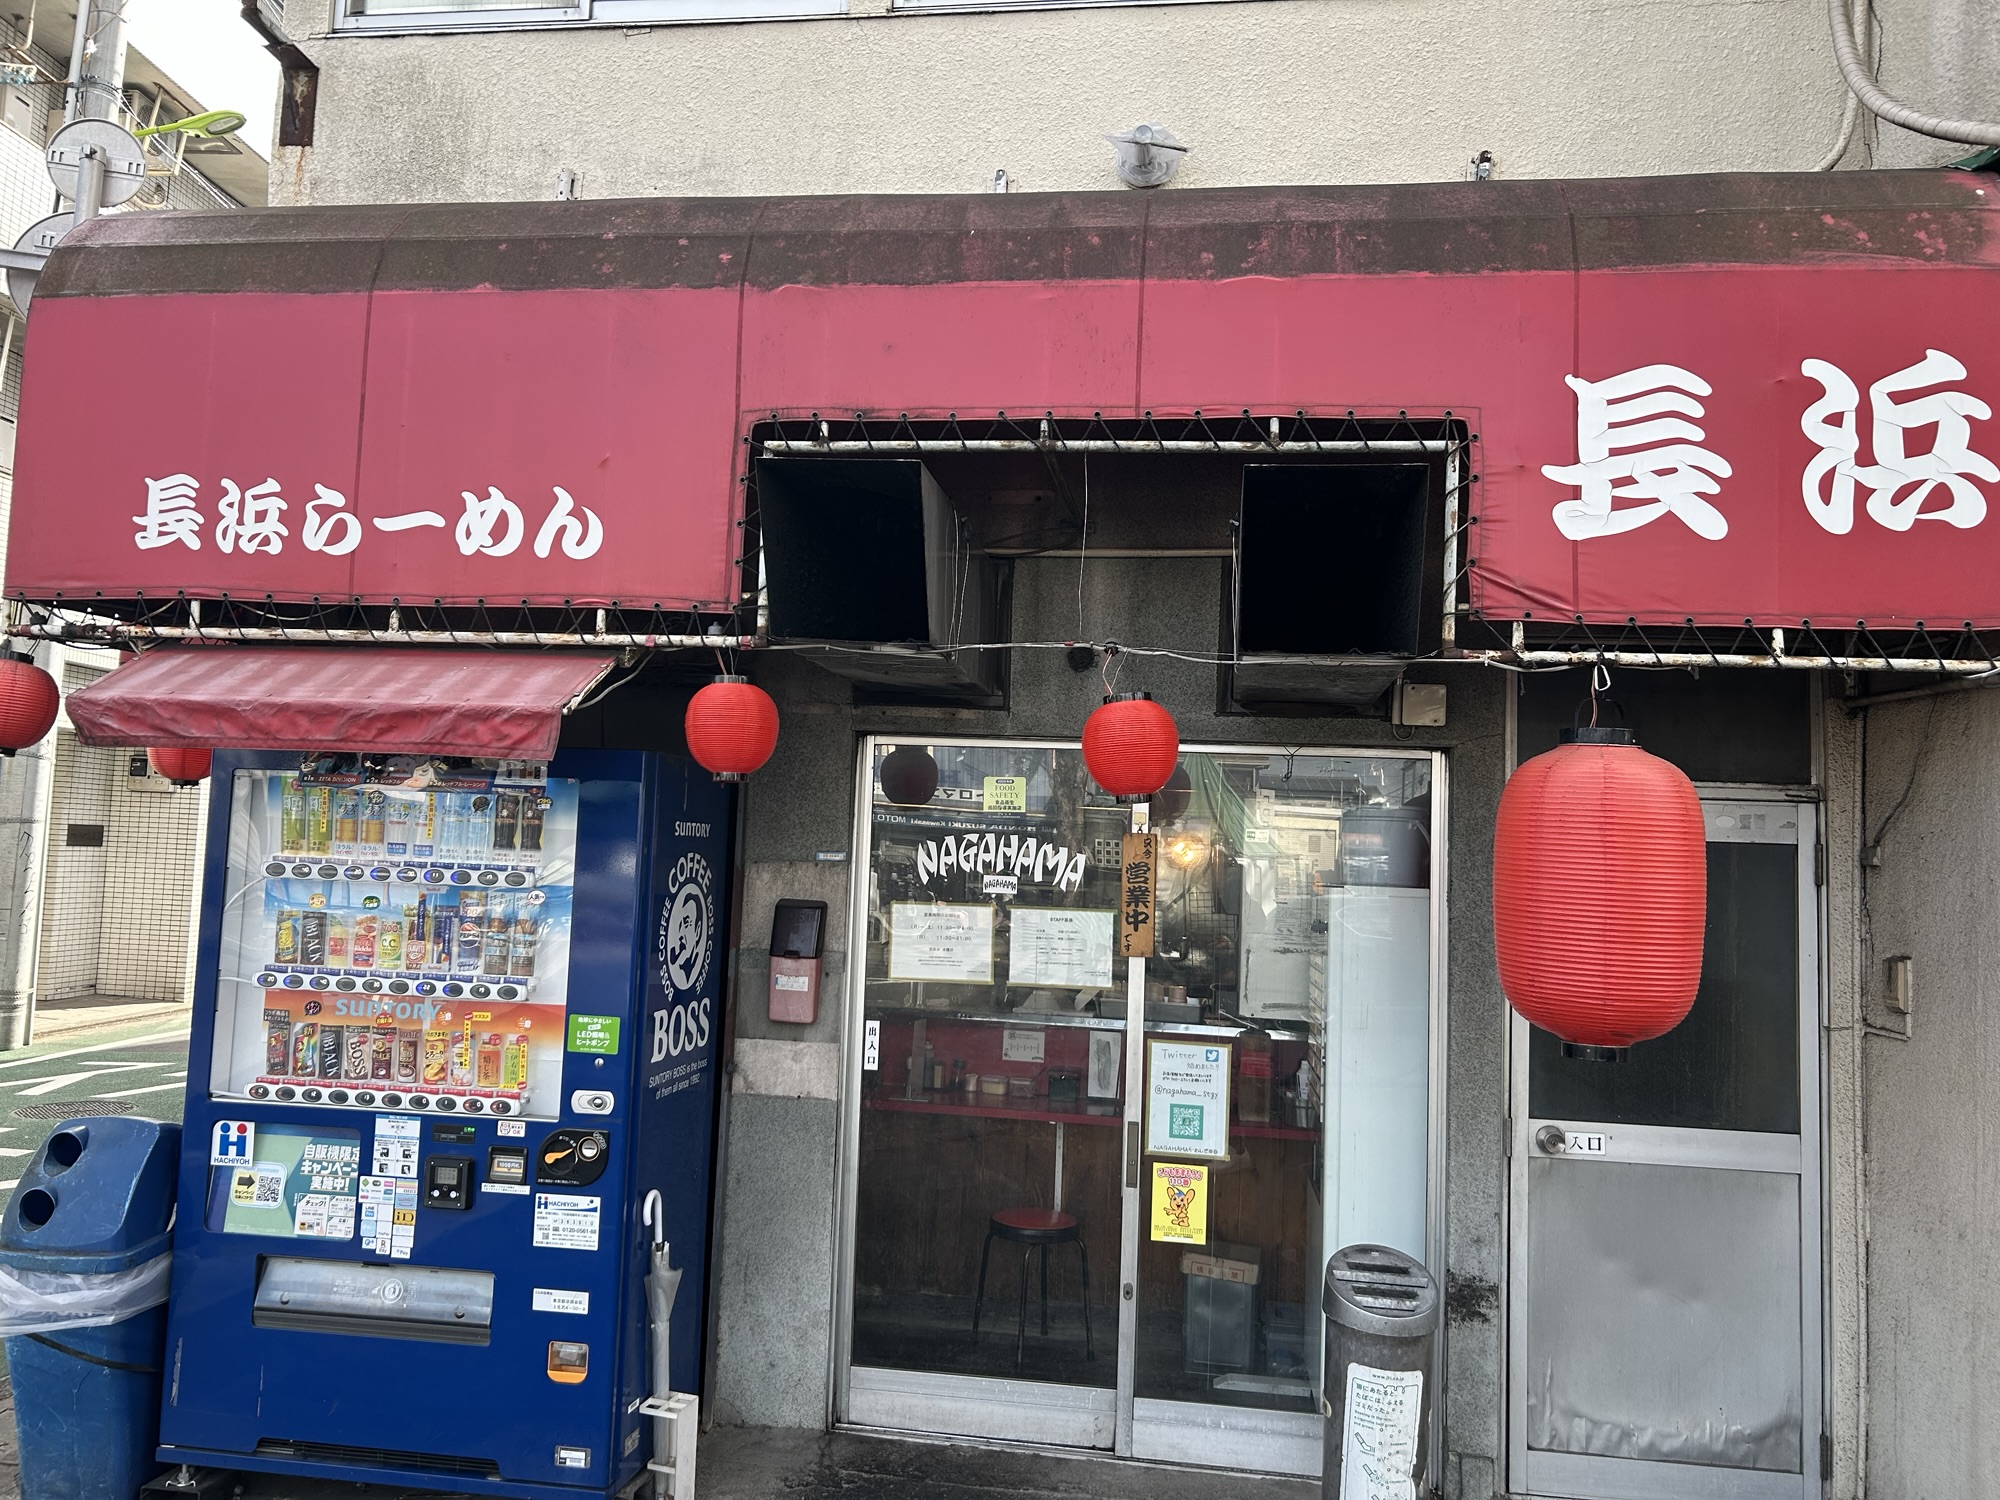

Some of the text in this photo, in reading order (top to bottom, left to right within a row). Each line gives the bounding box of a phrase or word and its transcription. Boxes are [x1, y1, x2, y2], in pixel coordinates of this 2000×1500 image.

[1541, 349, 2000, 541] 長浜
[133, 473, 604, 561] 長浜らーめん
[674, 821, 711, 837] SUNTORY
[668, 852, 712, 893] COFFEE
[917, 833, 1086, 892] NAGAHAMA
[984, 879, 1017, 891] NAGAHAMA
[1125, 861, 1151, 932] 営業中
[304, 918, 323, 962] BLACK
[658, 896, 672, 961] COFFEE
[1124, 933, 1133, 952] です
[695, 941, 713, 995] COFFEE
[335, 998, 442, 1021] SUNTORY
[576, 1039, 611, 1047] ヒートポンプ
[651, 998, 711, 1064] BOSS
[867, 1026, 877, 1064] 出入口
[321, 1031, 340, 1077] BLACK
[350, 1038, 366, 1076] BOSS
[1162, 1049, 1198, 1060] Twitter
[213, 1157, 250, 1165] HACHIYOH
[304, 1144, 360, 1160] 自販機限定
[1569, 1134, 1602, 1153] 入口
[311, 1176, 349, 1190] 実施中!
[396, 1211, 415, 1223] iD
